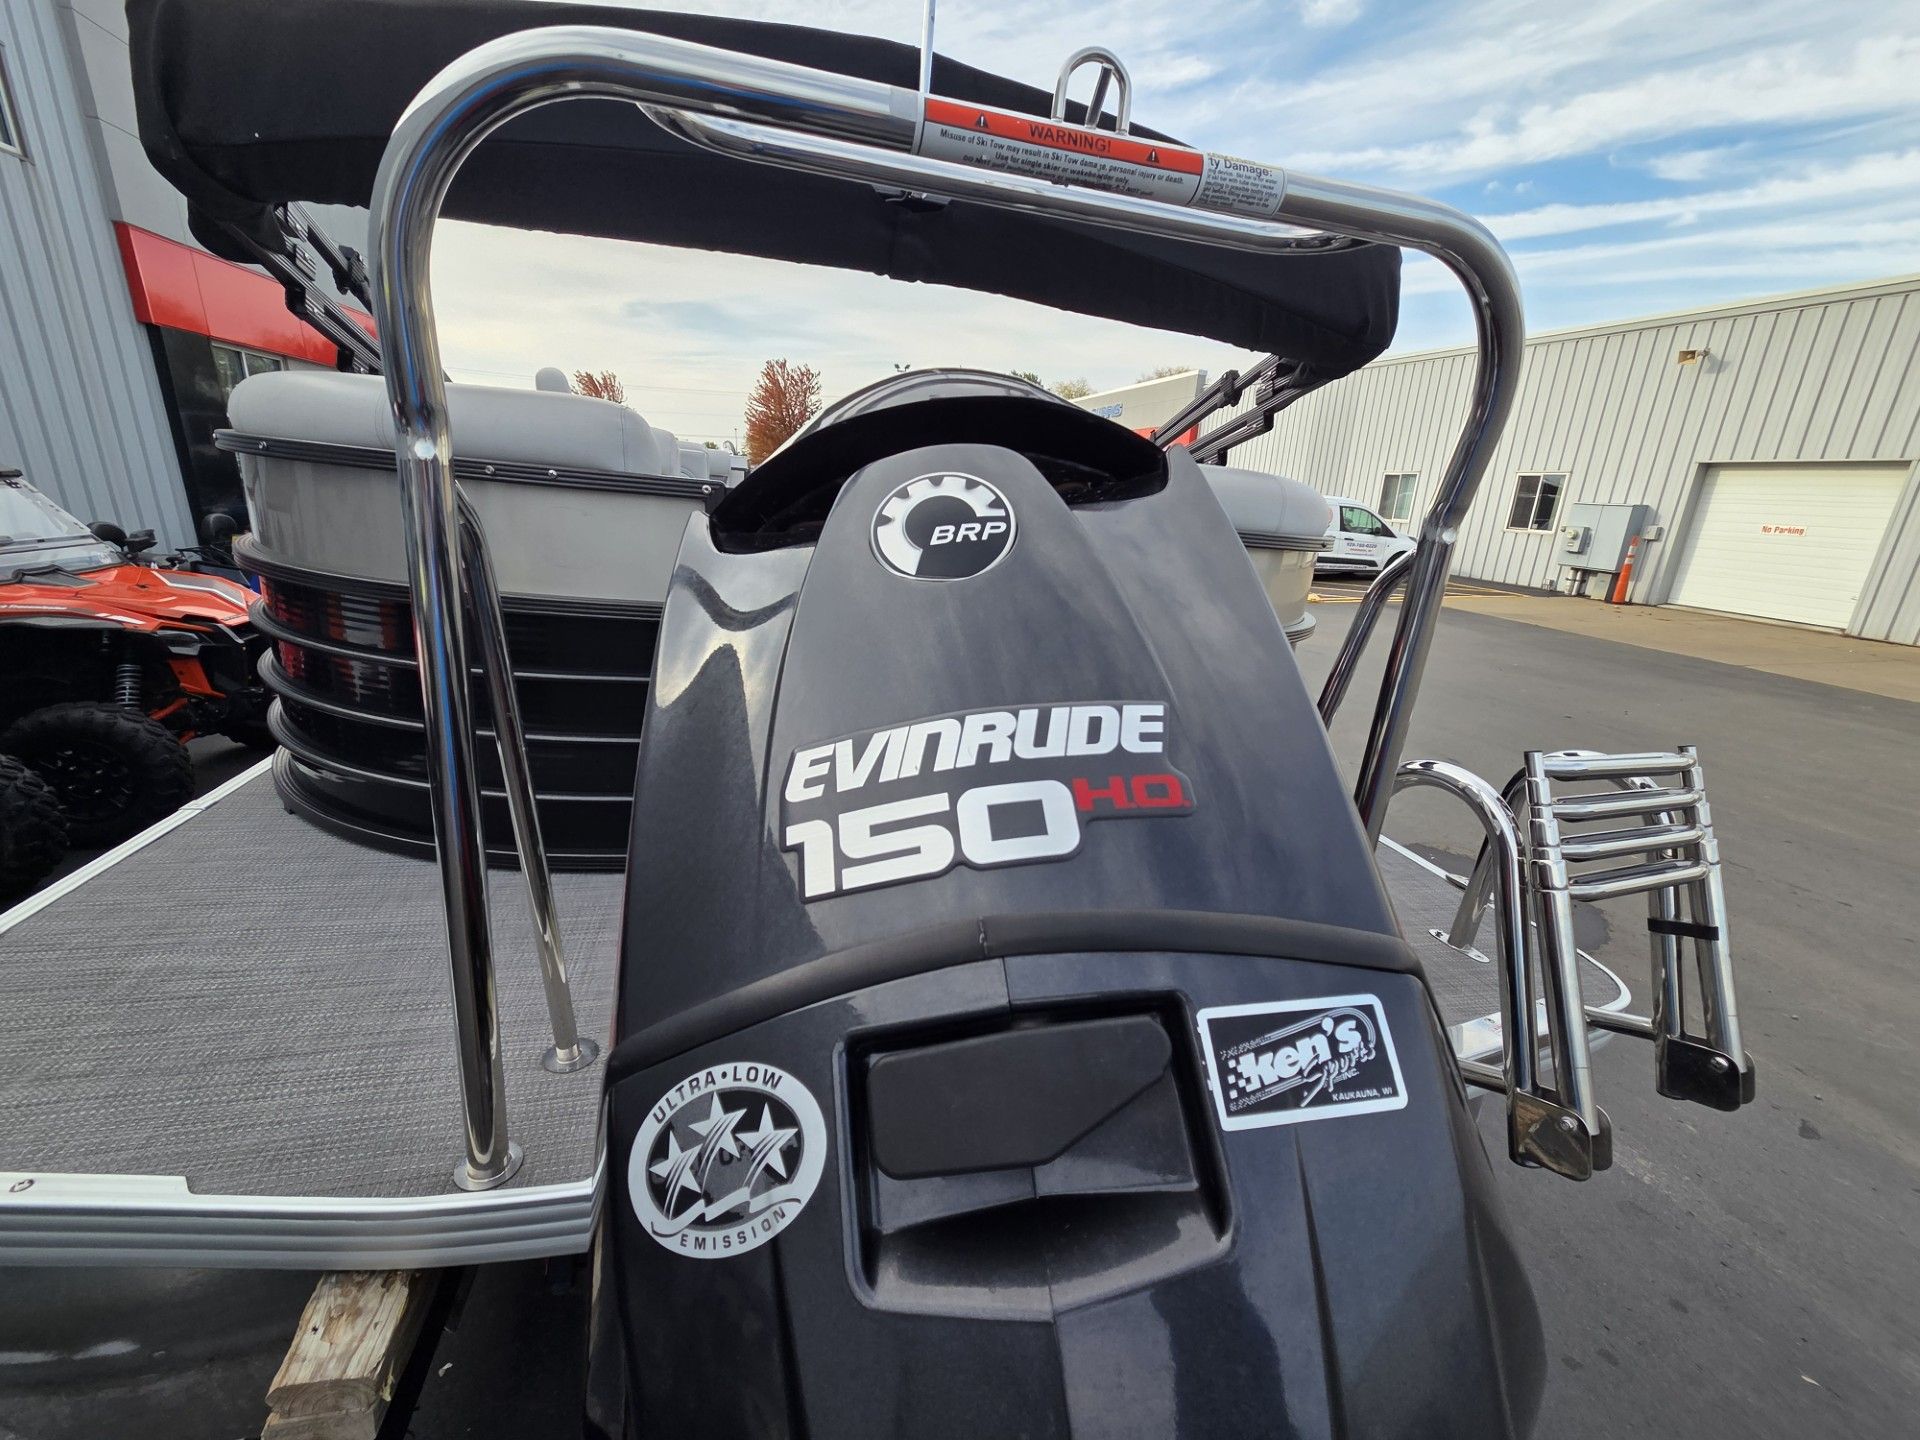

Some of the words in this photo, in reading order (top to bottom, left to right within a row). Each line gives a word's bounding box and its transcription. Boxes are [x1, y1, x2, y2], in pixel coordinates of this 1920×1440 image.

[1029, 123, 1112, 153] WARNING!
[940, 128, 966, 143] Misuse
[968, 134, 975, 144] of
[976, 136, 988, 146] Ski
[990, 139, 1004, 150] Tow
[1006, 145, 1020, 154] may
[1021, 147, 1041, 156] result
[1042, 150, 1050, 159] in
[1050, 152, 1062, 162] Ski
[1064, 154, 1078, 165] Tow
[1108, 164, 1138, 176] personal
[1138, 169, 1156, 180] injury
[995, 152, 1008, 161] Use
[1010, 154, 1020, 162] for
[1021, 157, 1042, 168] single
[1043, 162, 1060, 172] skier
[1224, 158, 1273, 178] Damage:
[929, 521, 1008, 546] BRP
[1774, 526, 1804, 536] Parking
[784, 704, 1164, 803] EVINRUDE
[785, 779, 1081, 898] 150
[1342, 1067, 1361, 1081] INC.
[1332, 1088, 1380, 1102] KAUKAUNA,
[1382, 1086, 1393, 1096] WI
[679, 1205, 786, 1250] EMISSION
